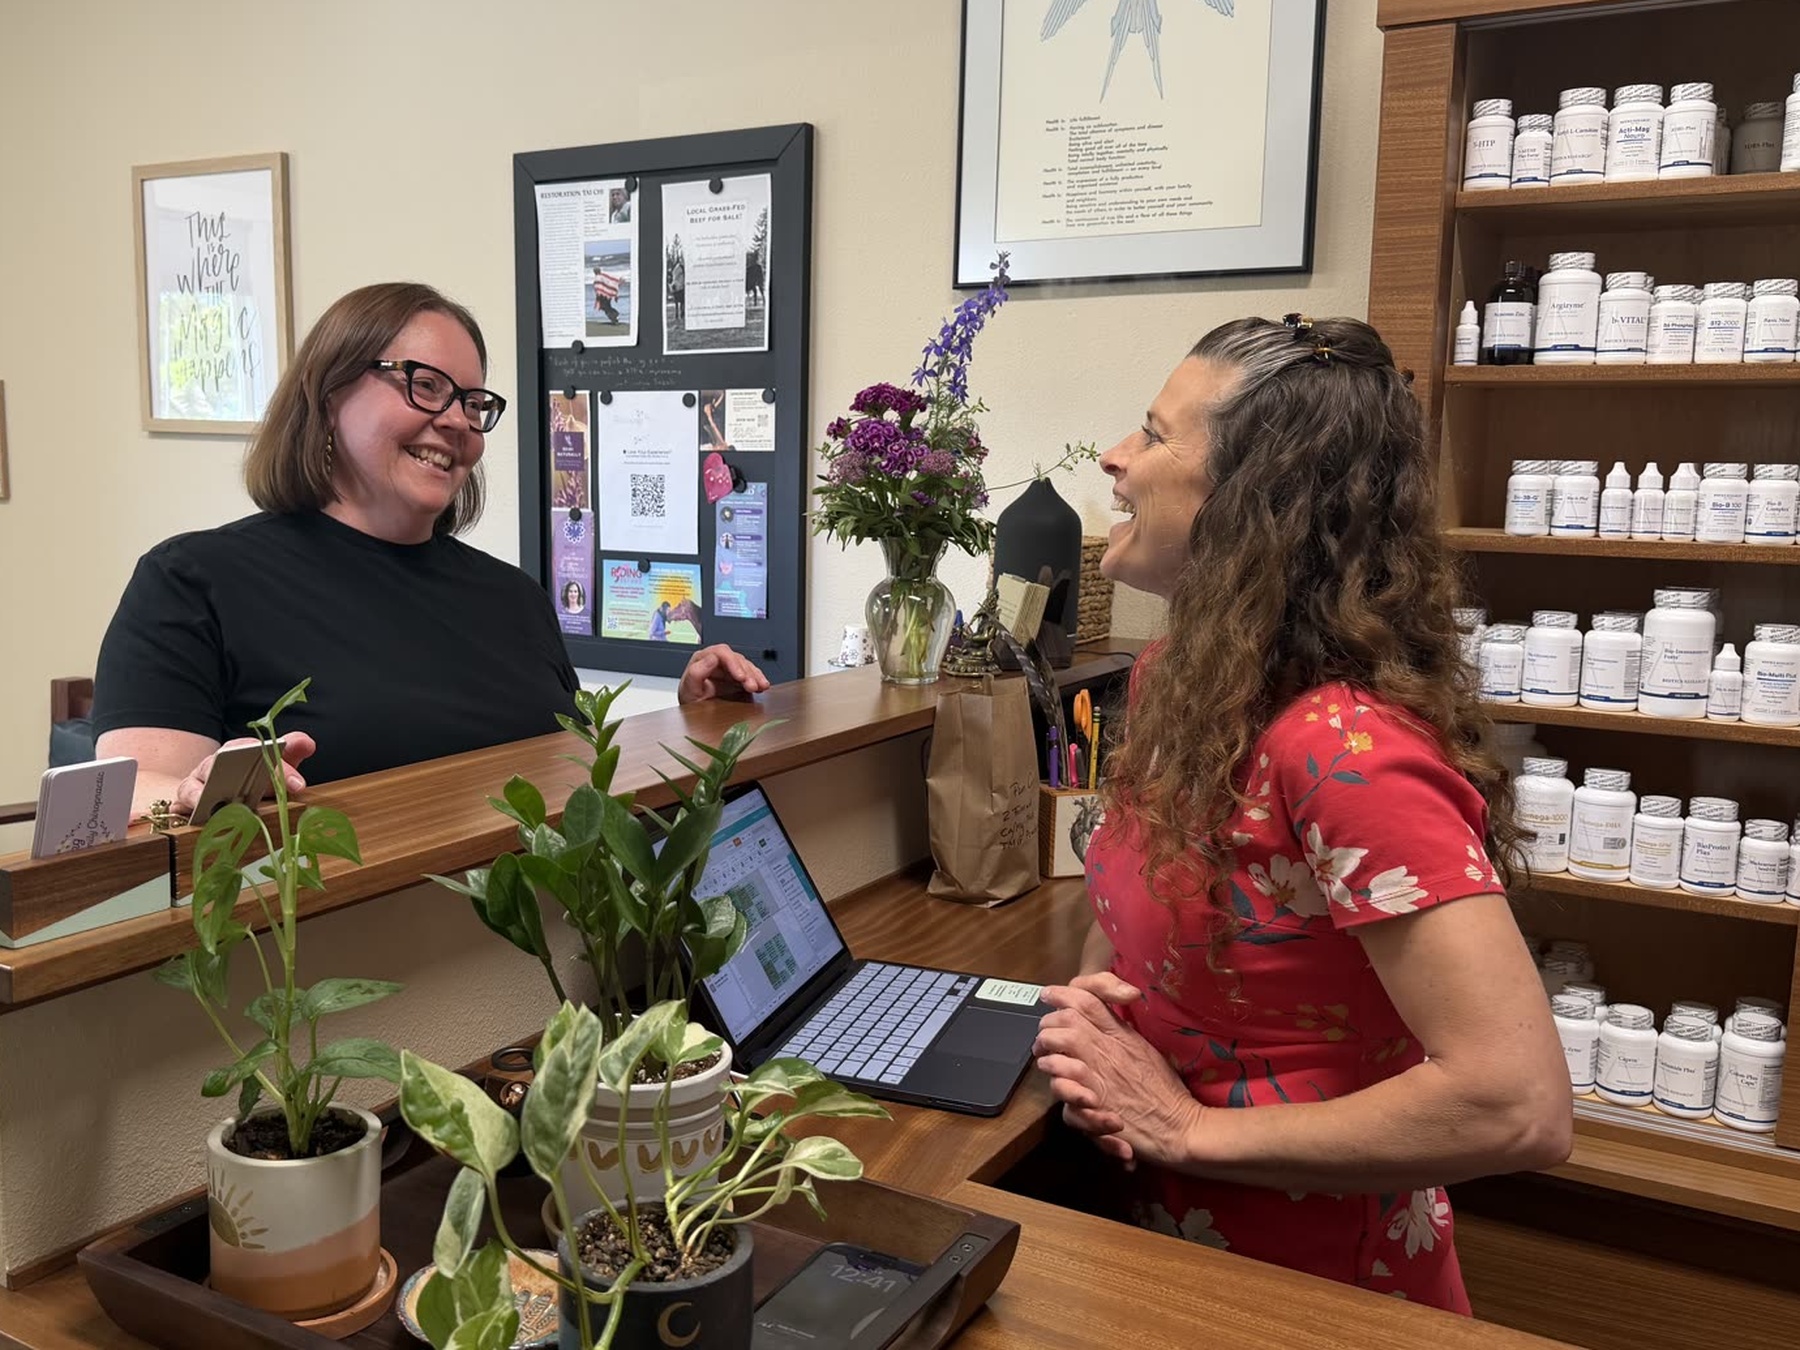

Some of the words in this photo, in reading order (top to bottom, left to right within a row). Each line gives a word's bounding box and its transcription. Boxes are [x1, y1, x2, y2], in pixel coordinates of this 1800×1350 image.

[686, 208, 706, 216] LOCAL
[184, 210, 231, 248] This
[87, 771, 105, 830] Chiropractic
[830, 1264, 897, 1293] 12:41
